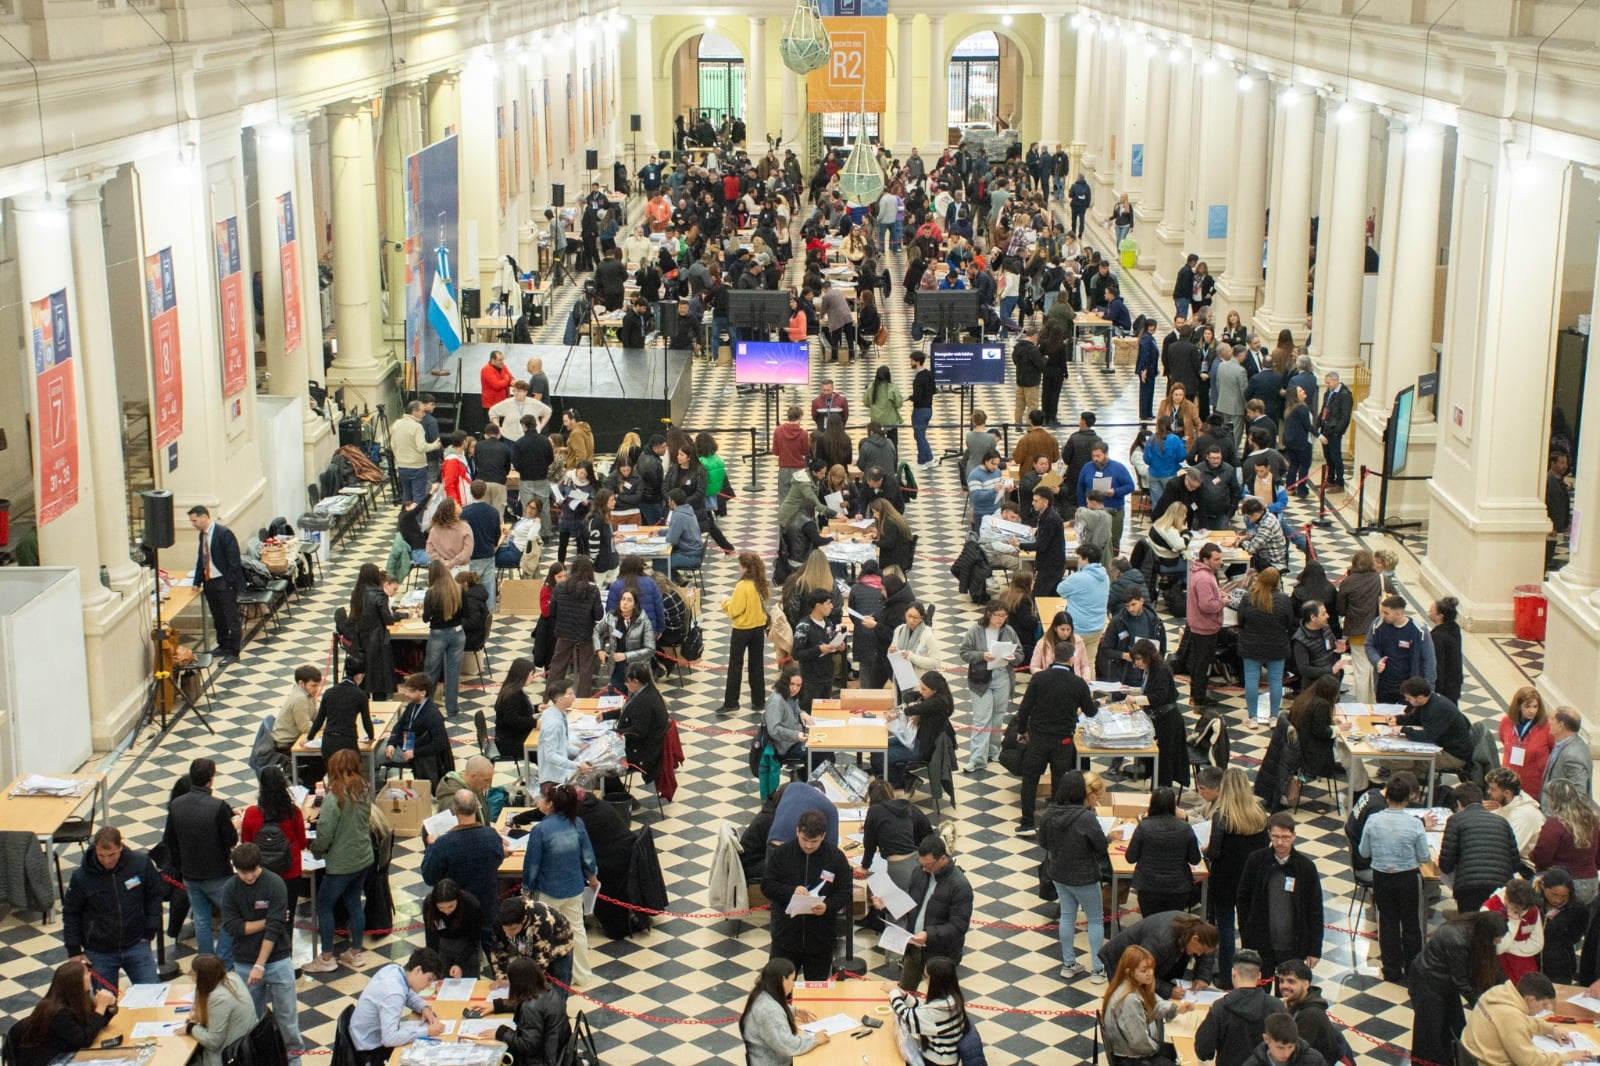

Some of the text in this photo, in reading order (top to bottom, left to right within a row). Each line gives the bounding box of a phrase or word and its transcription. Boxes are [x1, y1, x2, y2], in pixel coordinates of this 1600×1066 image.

[833, 51, 861, 79] R2
[162, 342, 169, 375] 8
[52, 400, 62, 439] 7
